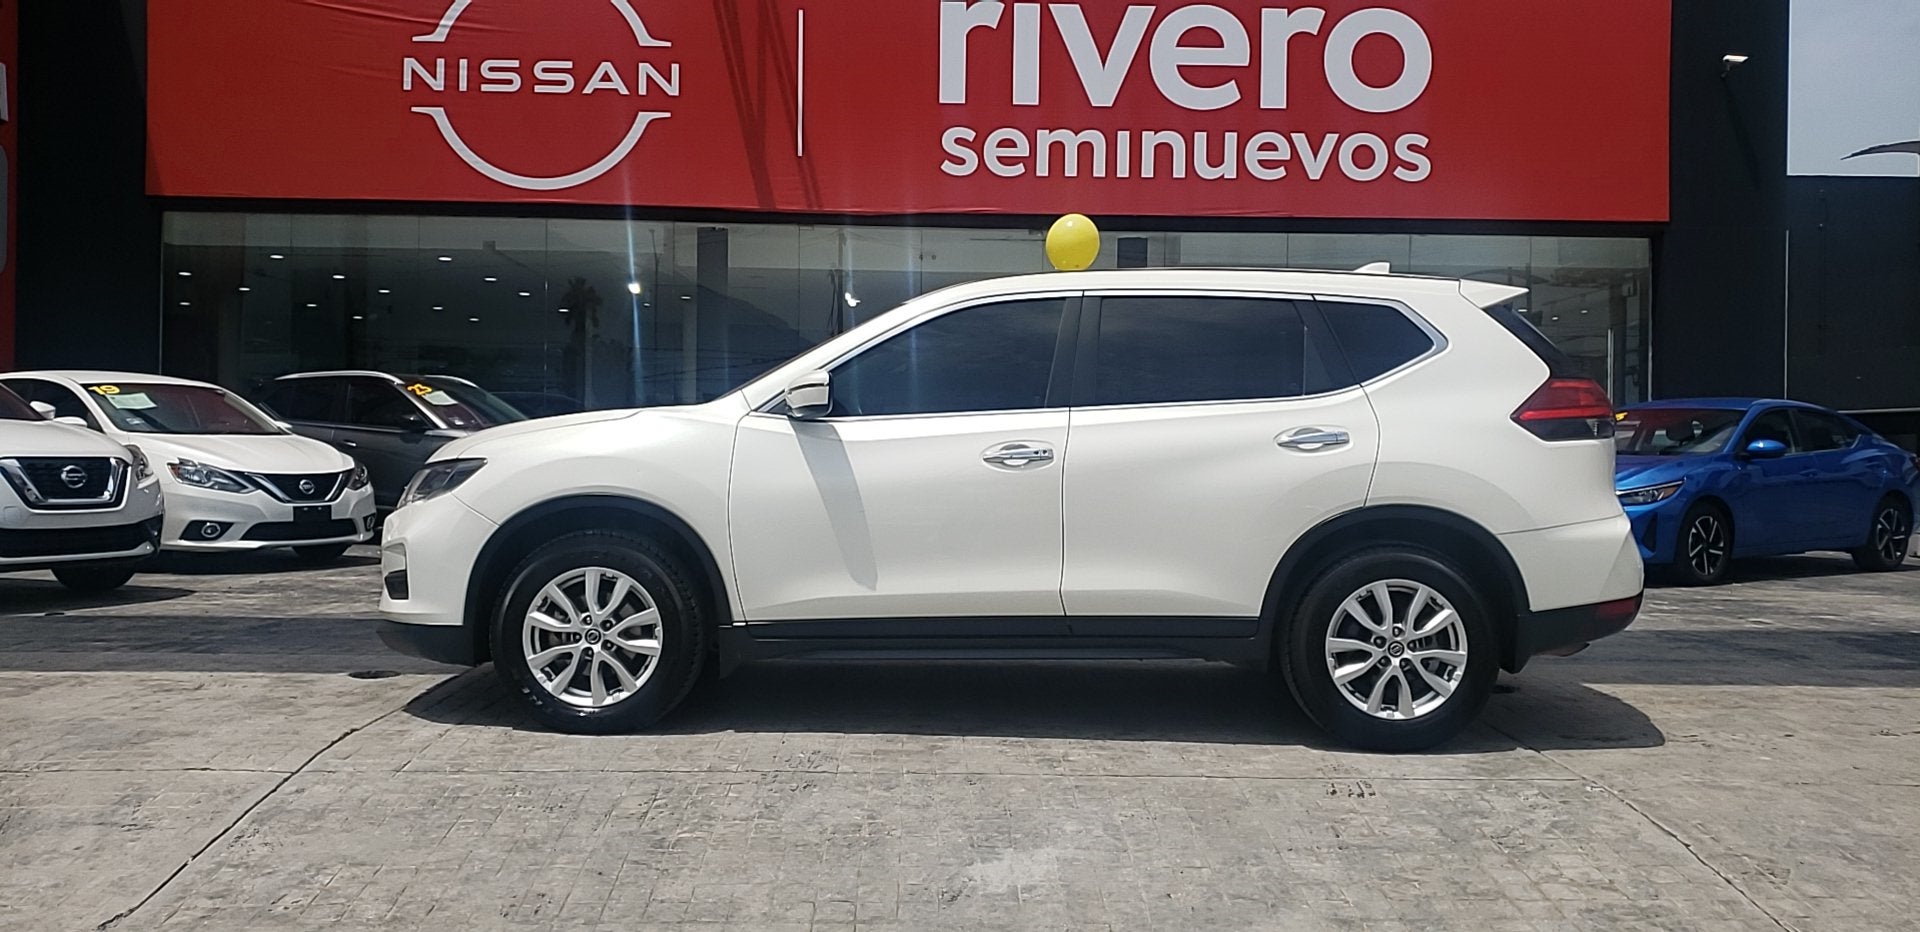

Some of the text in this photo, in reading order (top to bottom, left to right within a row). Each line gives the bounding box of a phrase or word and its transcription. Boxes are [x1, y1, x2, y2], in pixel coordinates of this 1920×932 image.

[403, 57, 680, 96] NISSAN
[938, 0, 1433, 113] rivero
[940, 126, 1431, 182] seminuevos
[89, 385, 120, 395] 19
